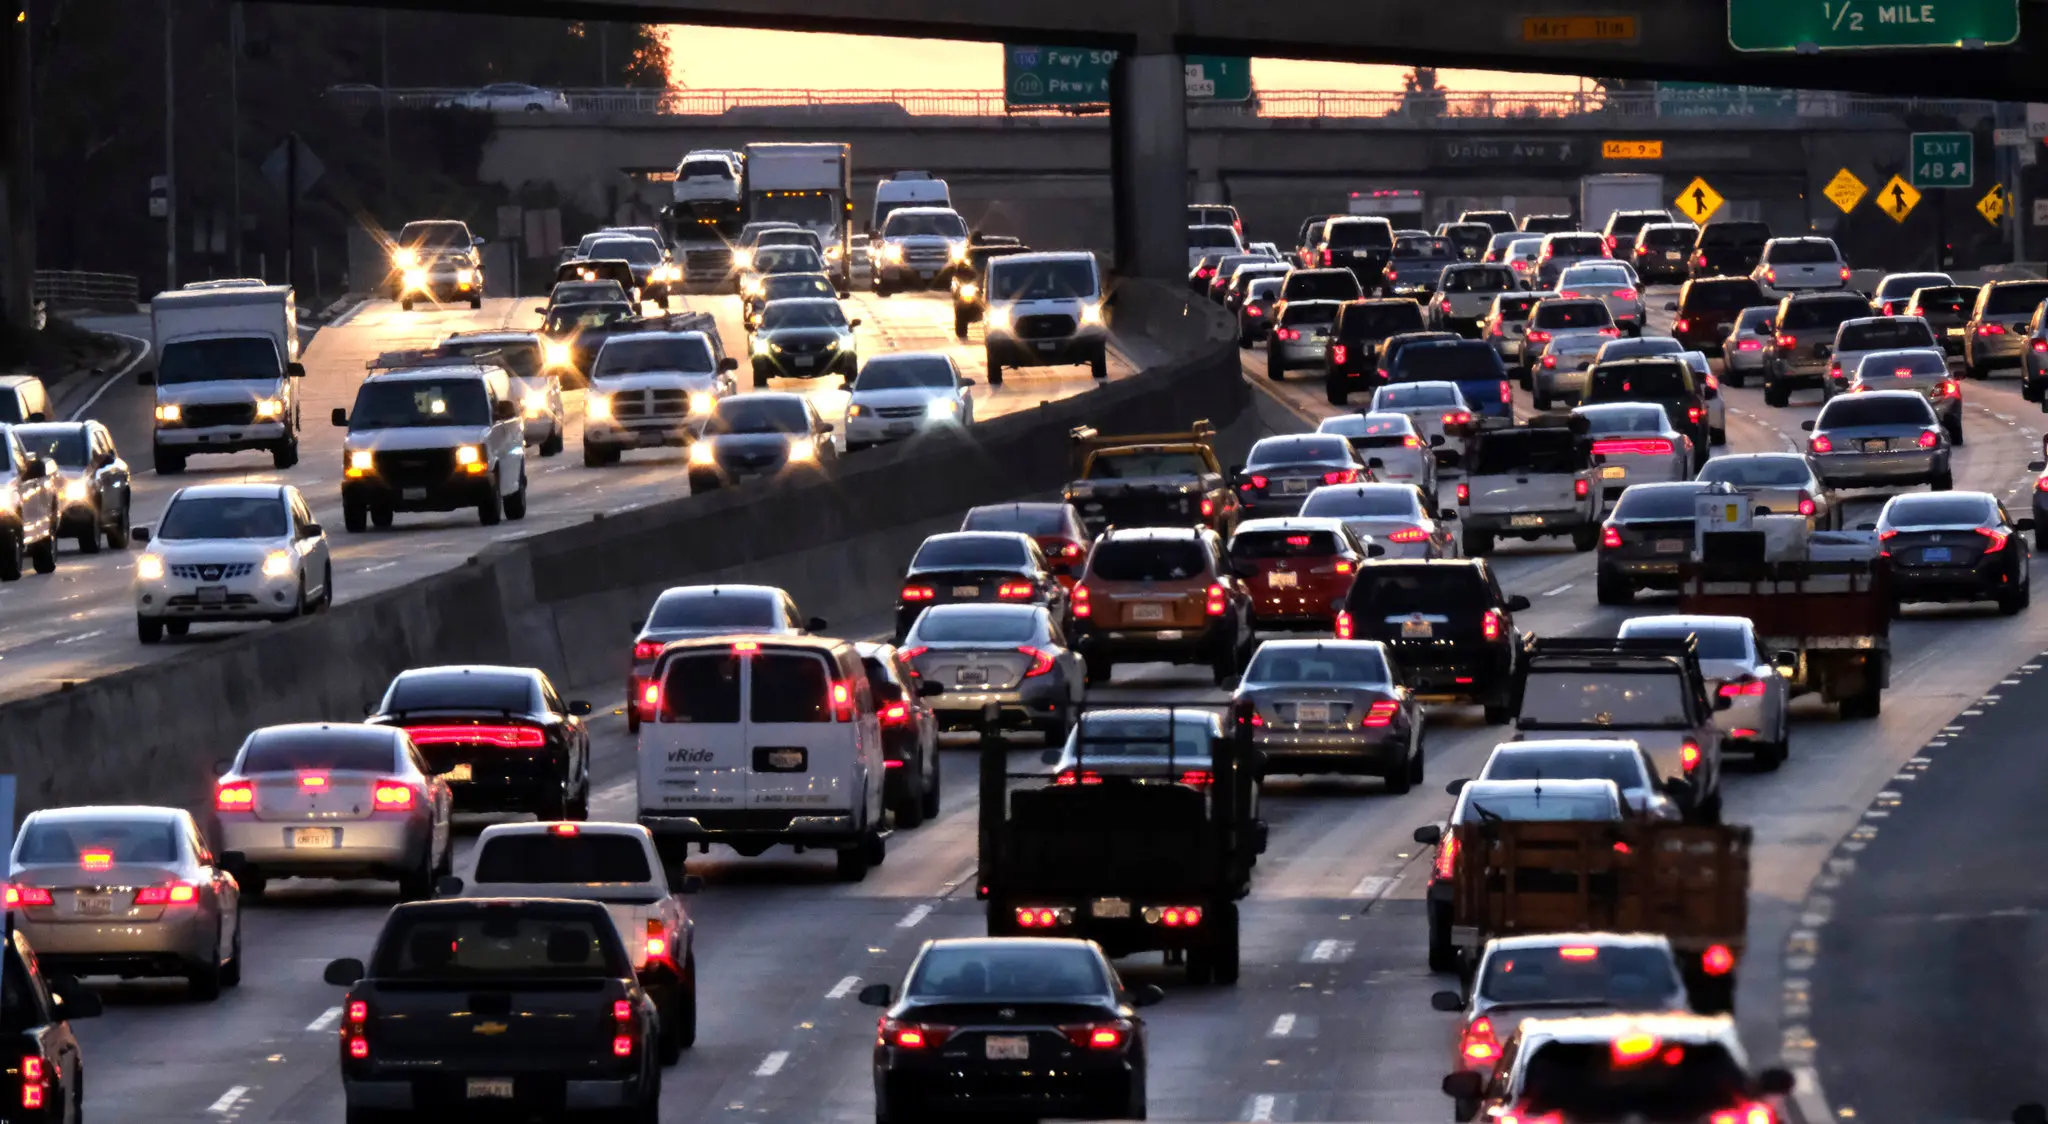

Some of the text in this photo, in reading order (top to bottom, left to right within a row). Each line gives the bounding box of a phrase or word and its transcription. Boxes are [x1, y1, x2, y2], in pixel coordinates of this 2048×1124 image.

[1823, 1, 1936, 31] 1/2 MILE
[1048, 51, 1082, 69] Fwy
[1048, 79, 1094, 93] Pkwy
[1448, 144, 1544, 158] Union Ave
[1606, 143, 1620, 154] 14
[1638, 144, 1646, 155] 9
[1923, 142, 1961, 155] EXIT
[1919, 162, 1944, 178] 4B
[667, 748, 714, 762] vRide
